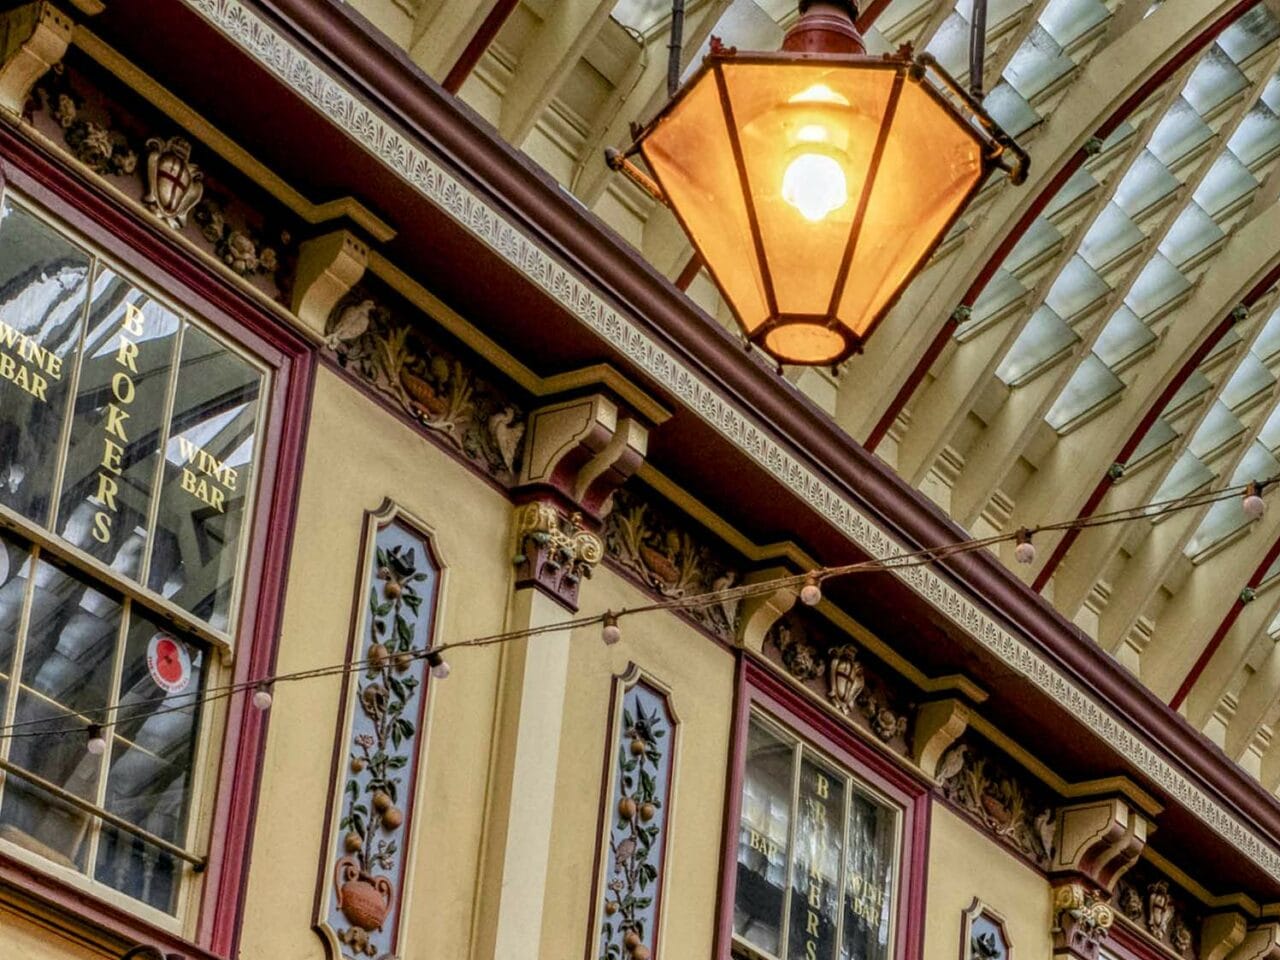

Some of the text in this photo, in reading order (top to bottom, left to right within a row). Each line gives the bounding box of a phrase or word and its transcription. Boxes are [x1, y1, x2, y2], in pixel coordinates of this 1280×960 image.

[0, 320, 63, 380] WINE
[0, 352, 48, 402] BAR
[92, 302, 147, 544] BROKERS
[178, 436, 239, 492] WINE
[181, 467, 225, 514] BAR
